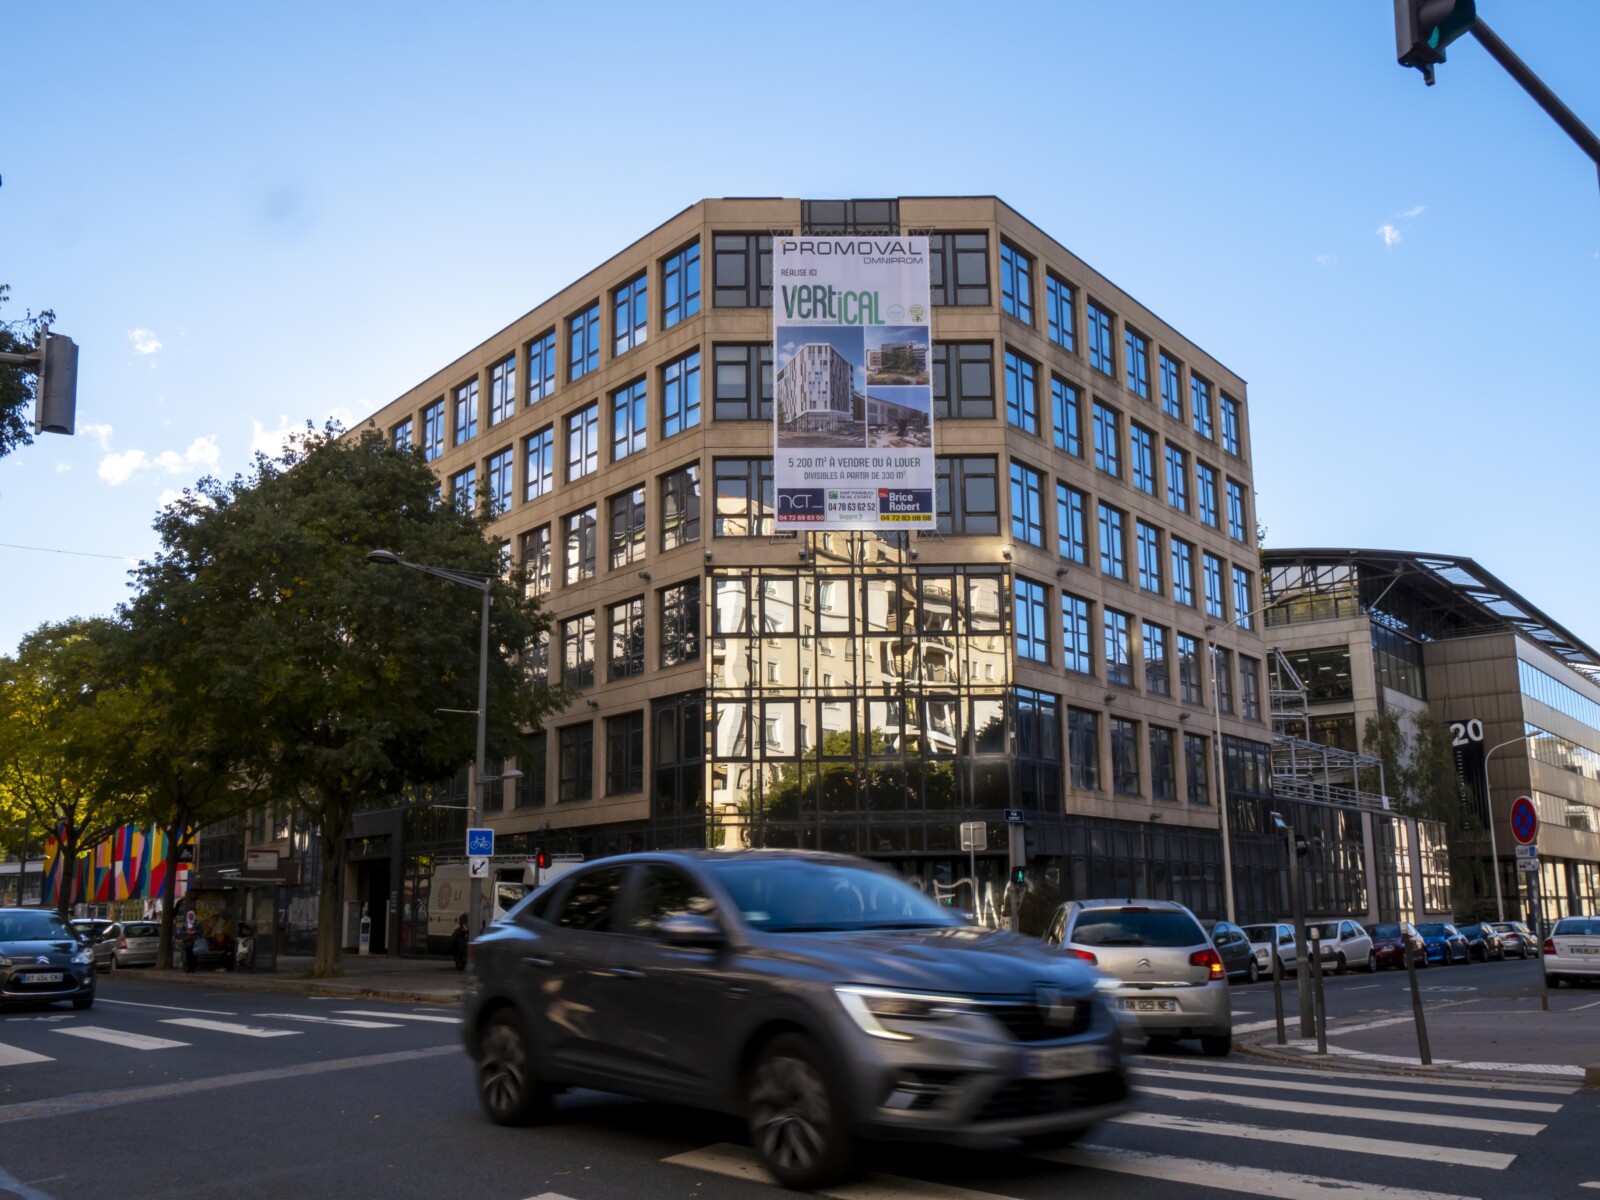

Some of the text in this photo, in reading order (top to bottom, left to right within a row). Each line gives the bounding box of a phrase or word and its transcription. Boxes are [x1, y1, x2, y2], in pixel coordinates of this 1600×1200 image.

[782, 241, 922, 255] PROMOVAL
[863, 257, 924, 265] OMNIPROM
[781, 268, 807, 277] RÉALISE
[788, 458, 794, 467] 5
[796, 458, 812, 467] 200
[829, 456, 835, 467] À
[838, 457, 870, 467] VENDRE
[872, 457, 883, 467] OU
[886, 456, 892, 467] À
[894, 457, 921, 467] LOUER
[804, 471, 838, 480] DIVISIBLES
[840, 470, 845, 480] À
[846, 471, 870, 480] PARTIR
[871, 471, 879, 480] DE
[881, 471, 895, 480] 330
[889, 492, 914, 502] Brice
[828, 502, 876, 512] 04 78 63 62 52
[889, 502, 920, 511] Robert
[1449, 718, 1484, 747] 20
[1517, 848, 1529, 856] SAUF
